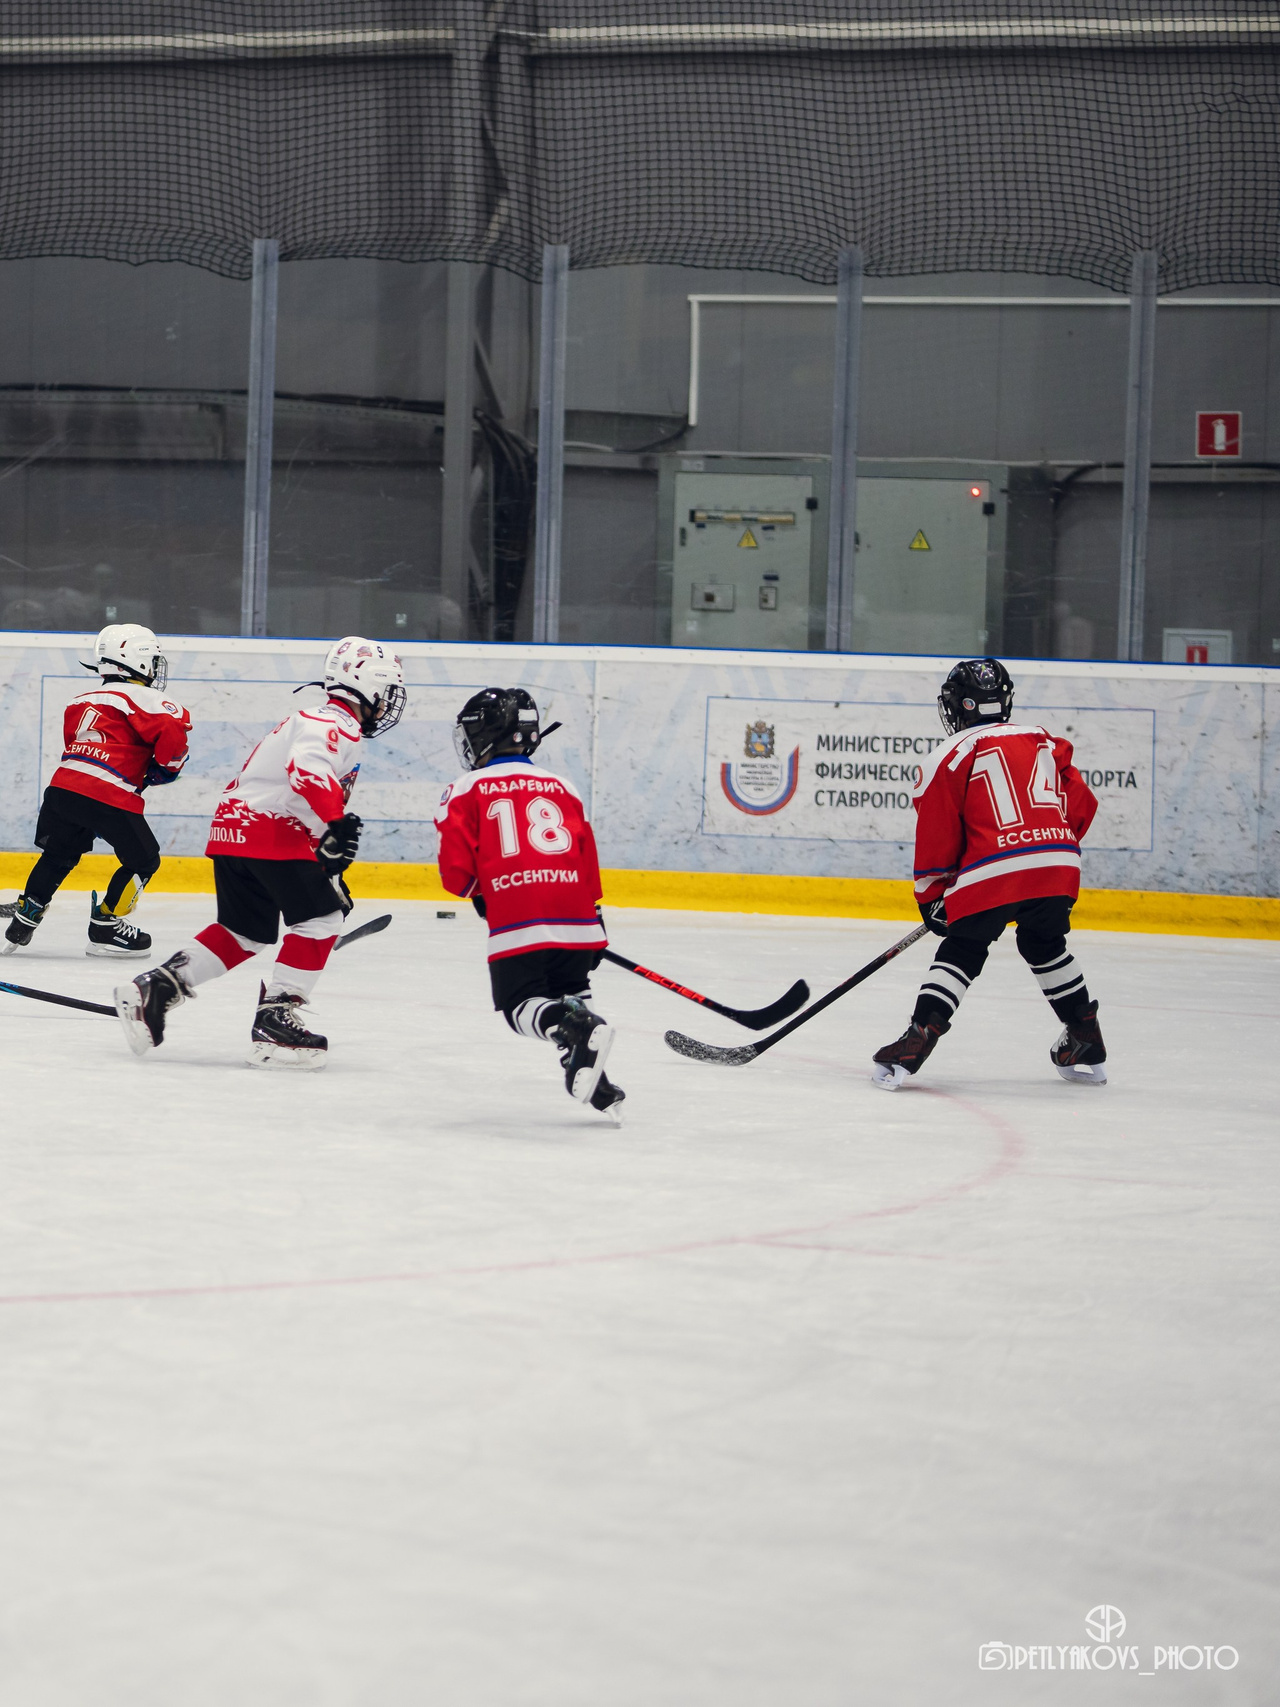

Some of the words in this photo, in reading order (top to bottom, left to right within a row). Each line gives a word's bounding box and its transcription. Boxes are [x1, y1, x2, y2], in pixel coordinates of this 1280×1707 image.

[326, 729, 338, 755] 9
[478, 779, 565, 795] НАЗАРЕВИЧ
[814, 790, 913, 809] СТАВРОПО
[969, 743, 1068, 830] 14
[486, 796, 572, 858] 18
[491, 868, 579, 892] ЕССЕНТУКИ
[633, 965, 707, 1004] FISCHER
